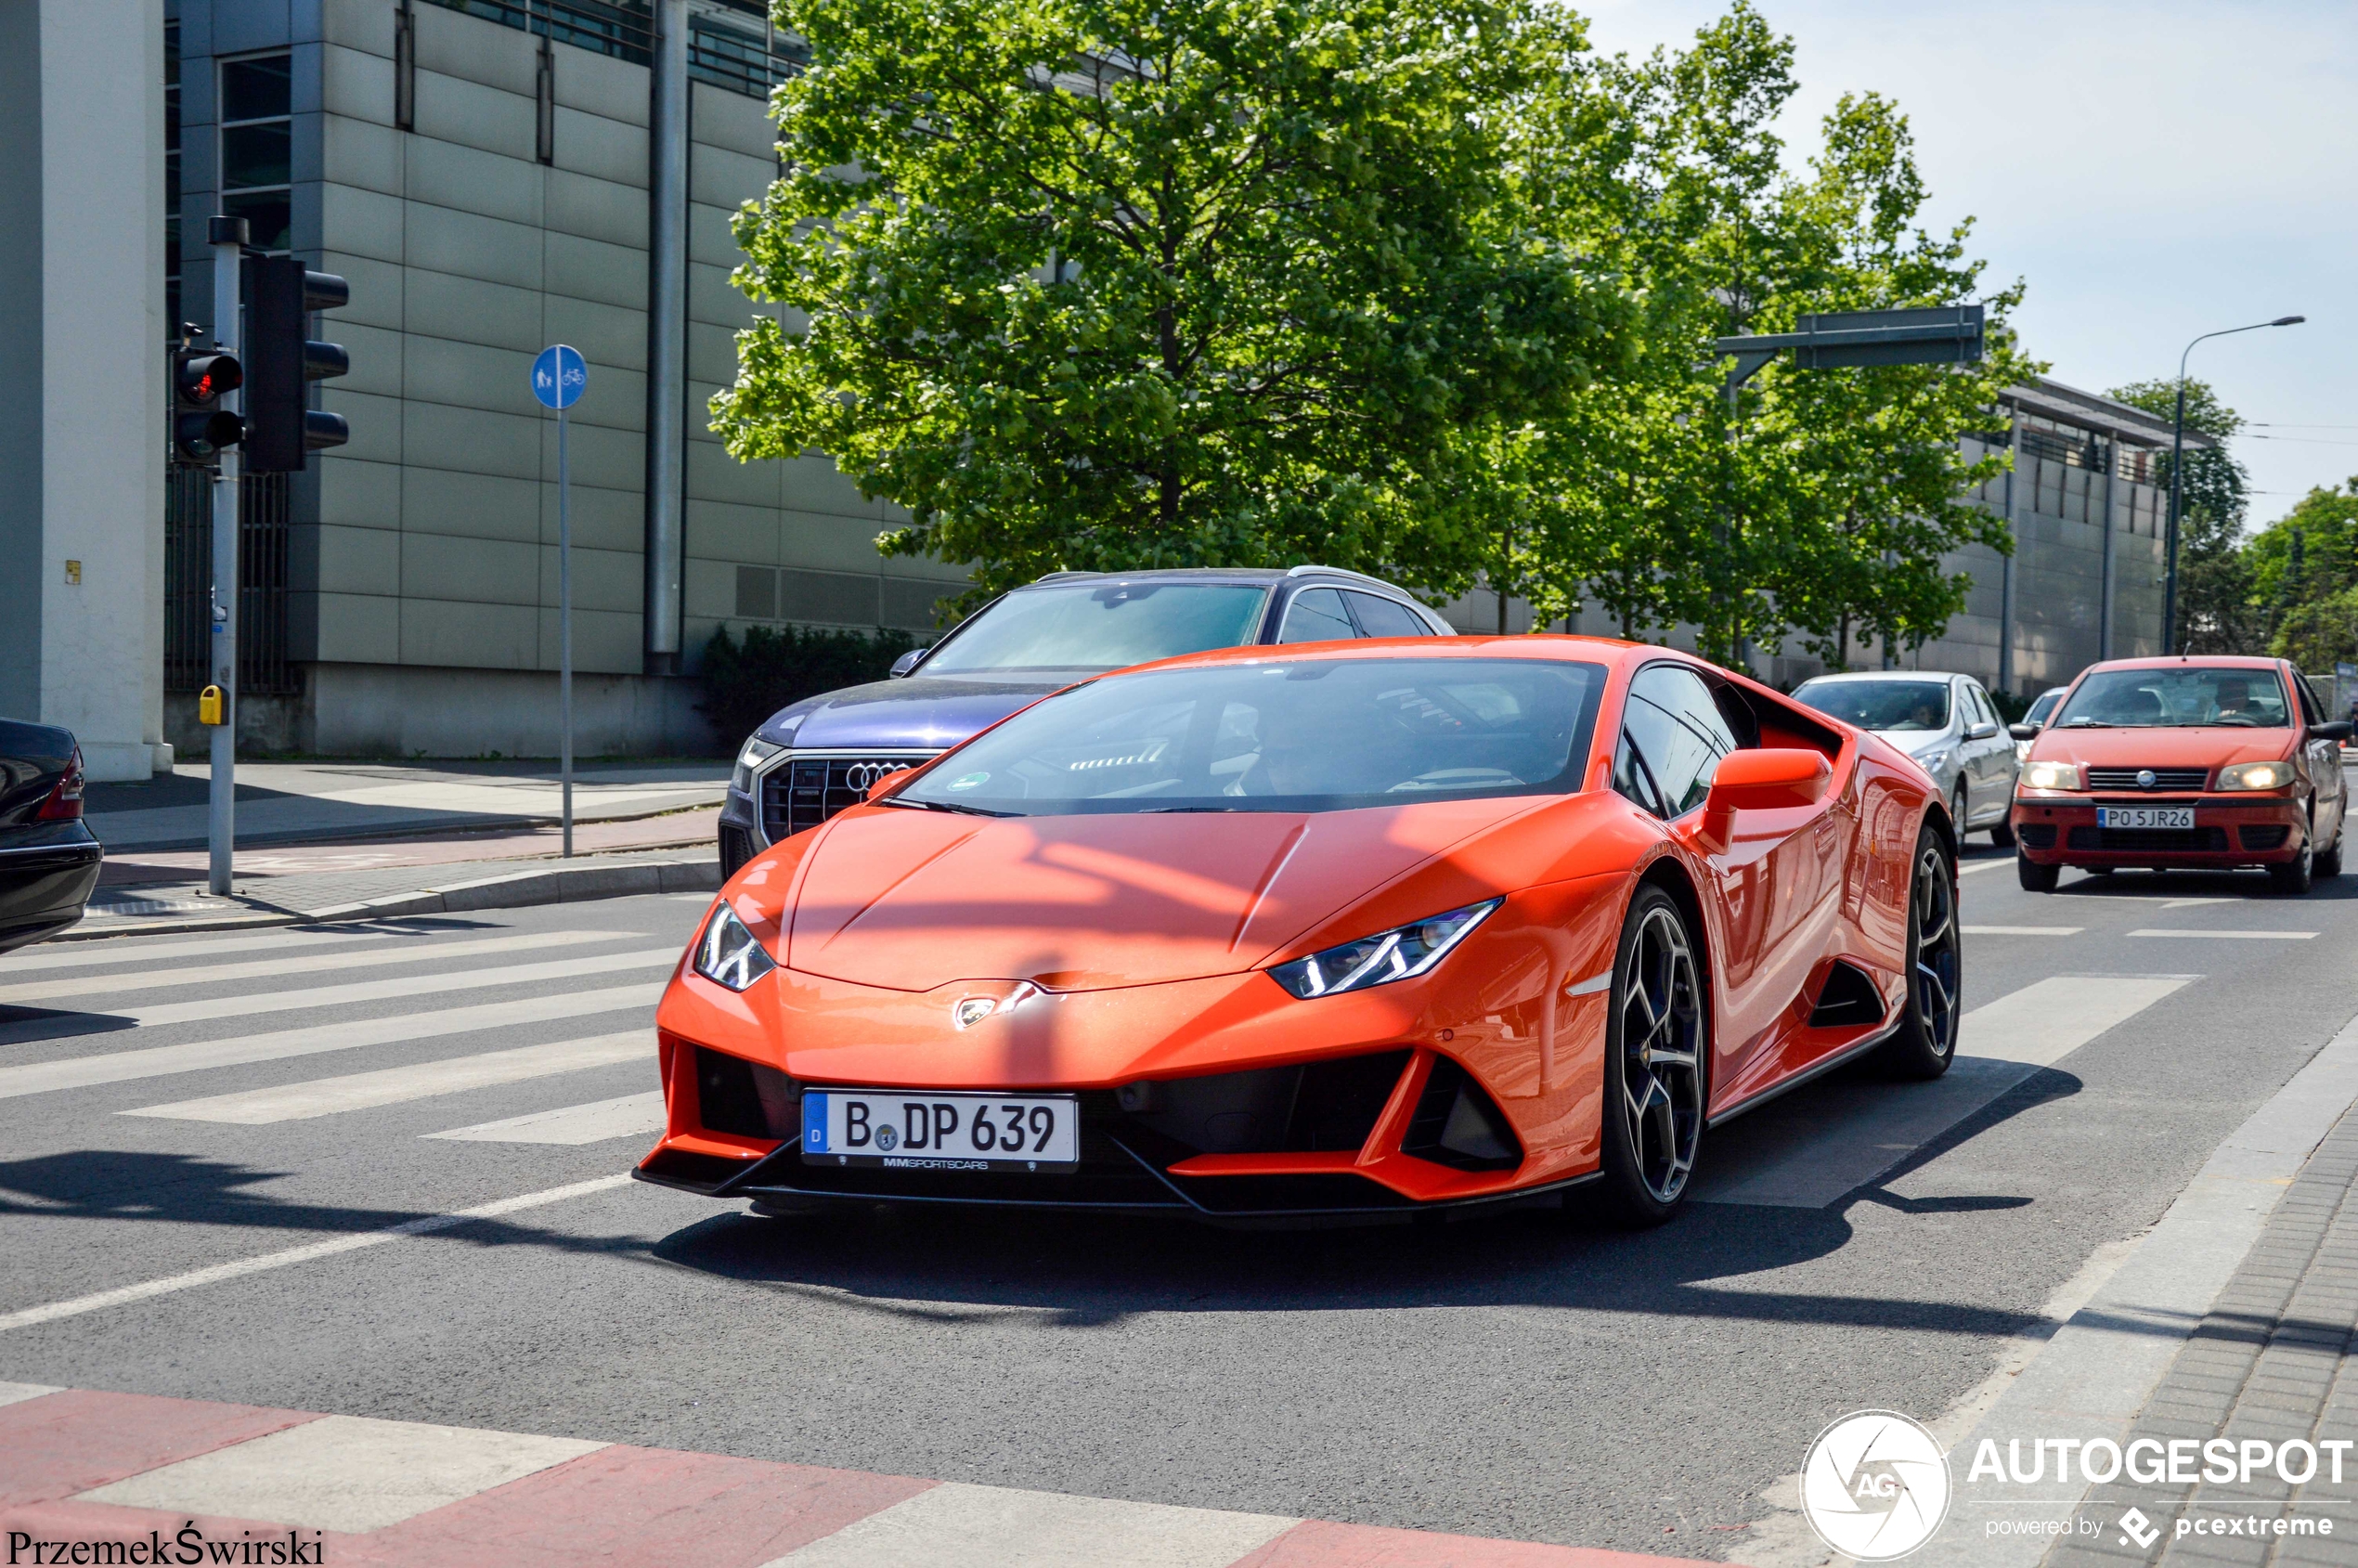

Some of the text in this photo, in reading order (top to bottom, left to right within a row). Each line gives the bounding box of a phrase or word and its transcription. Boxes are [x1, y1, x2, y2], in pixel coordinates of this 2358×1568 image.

[2137, 810, 2190, 827] 5JR26
[846, 1101, 1055, 1153] B DP 639
[811, 1129, 822, 1143] D
[883, 1158, 989, 1170] MMSPORTSCARS
